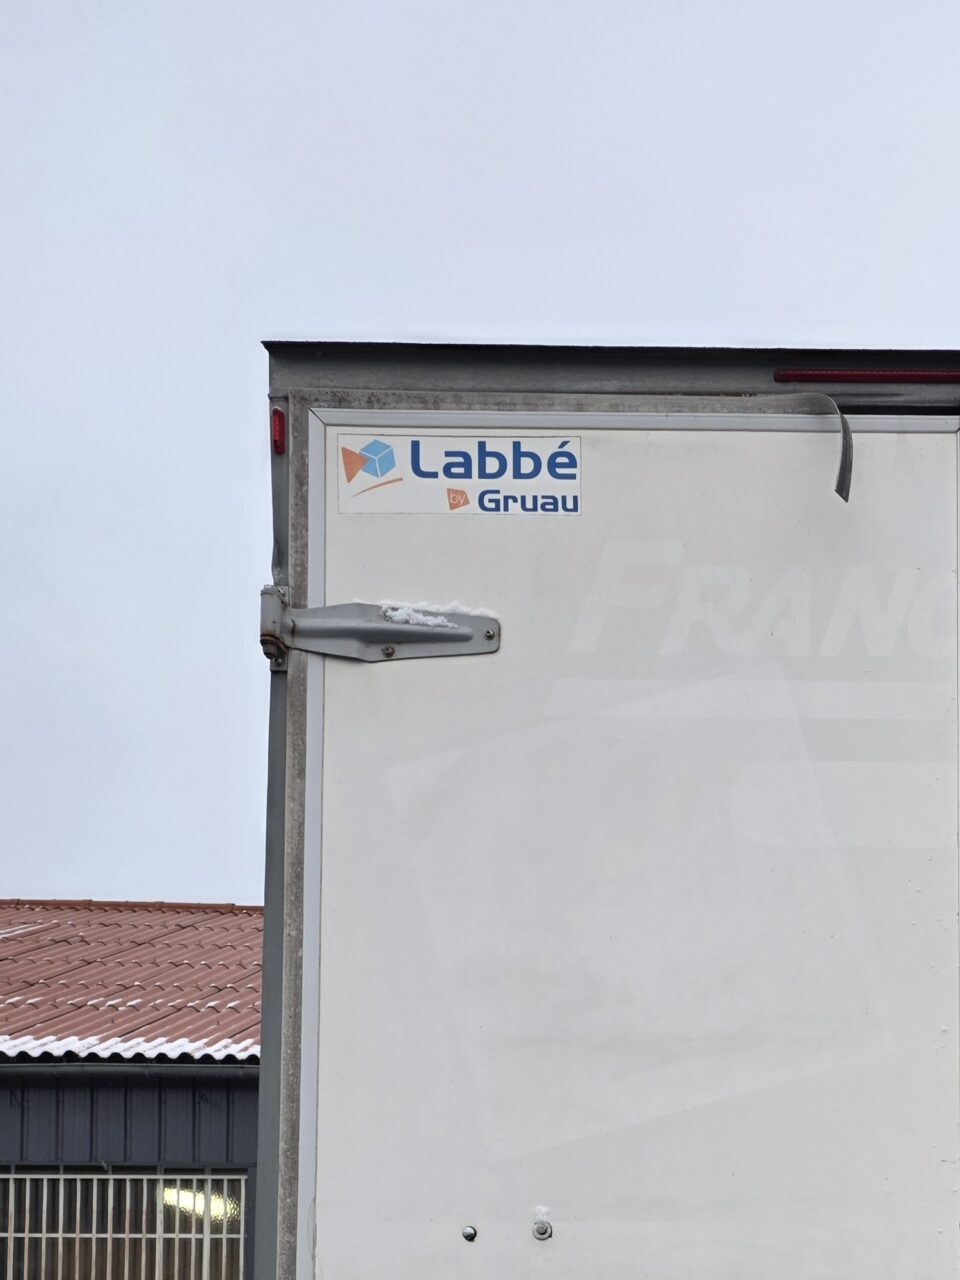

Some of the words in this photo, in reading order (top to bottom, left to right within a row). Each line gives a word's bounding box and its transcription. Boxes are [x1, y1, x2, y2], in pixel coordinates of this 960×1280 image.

[410, 439, 578, 480] Labbé
[449, 491, 466, 505] by
[477, 489, 580, 512] Gruau
